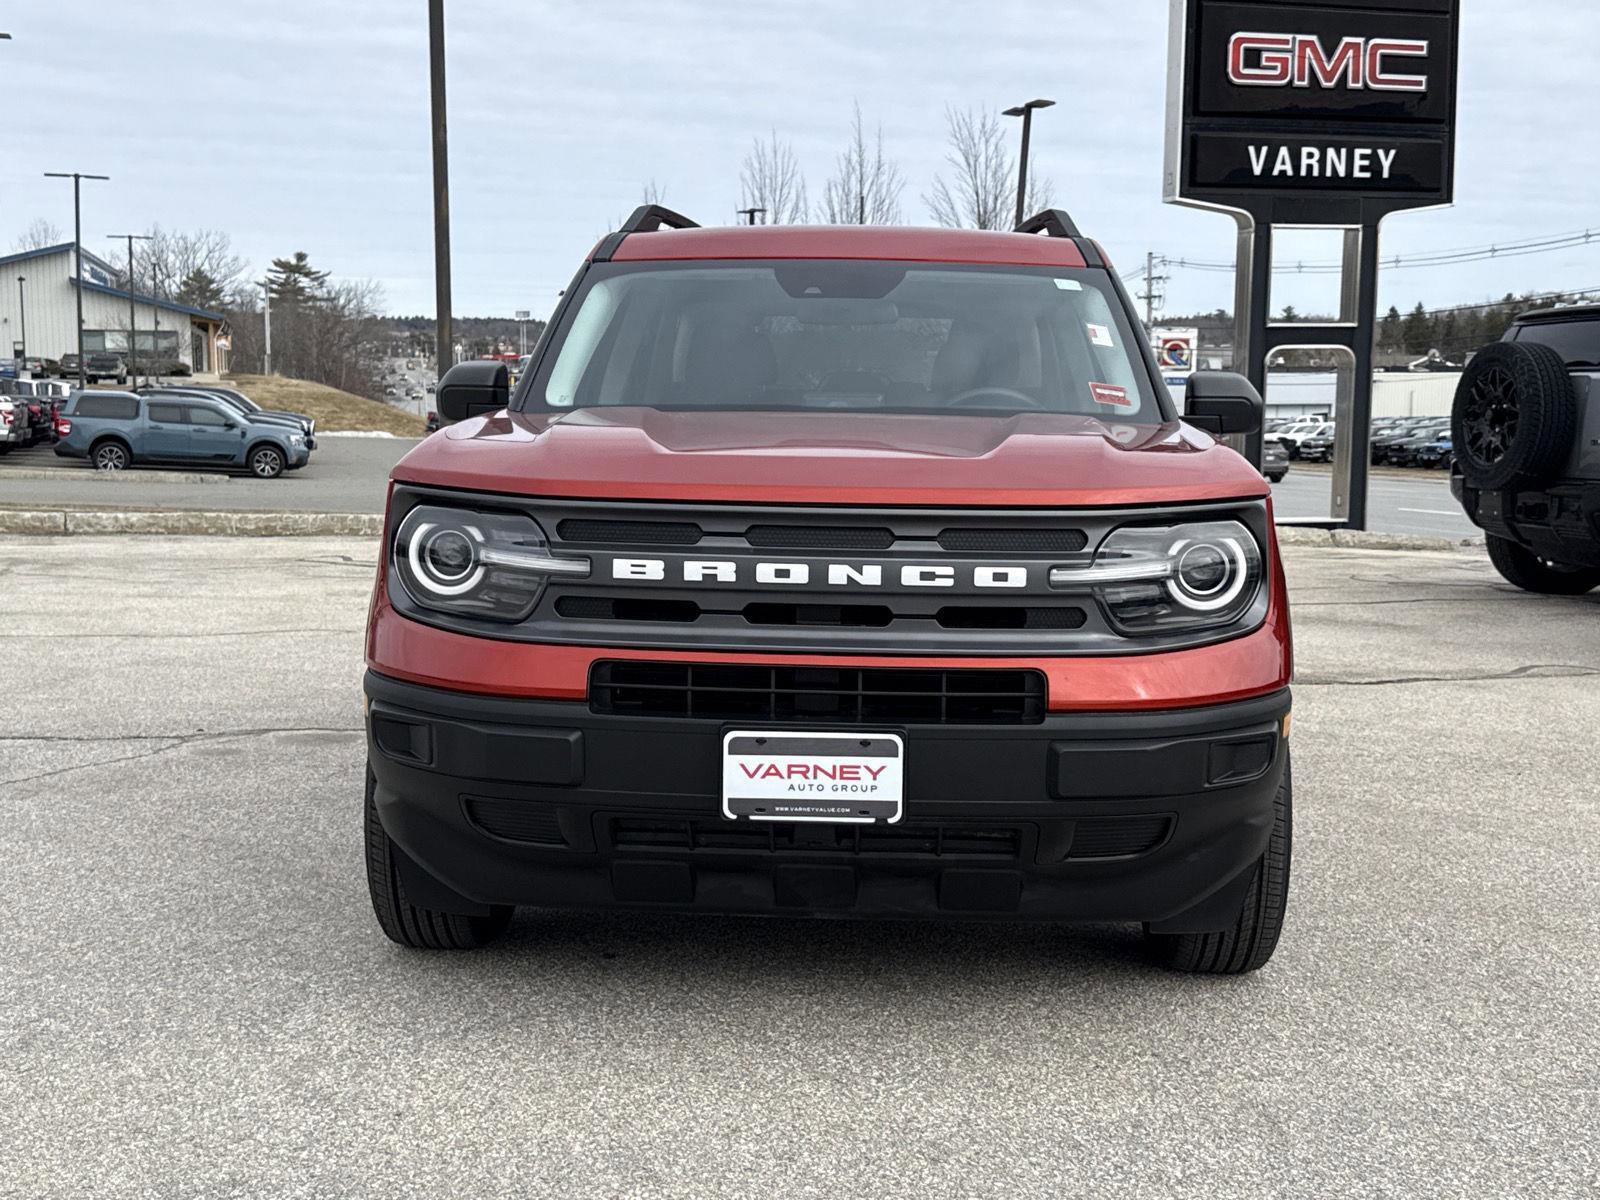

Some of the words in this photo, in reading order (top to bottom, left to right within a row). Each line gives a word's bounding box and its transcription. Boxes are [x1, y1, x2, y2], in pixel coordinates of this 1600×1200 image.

[1228, 31, 1429, 92] GMC
[1248, 145, 1397, 179] VARNEY
[612, 558, 1027, 588] BRONCO
[739, 763, 888, 781] VARNEY
[788, 784, 825, 792] AUTO
[832, 784, 878, 793] GROUP
